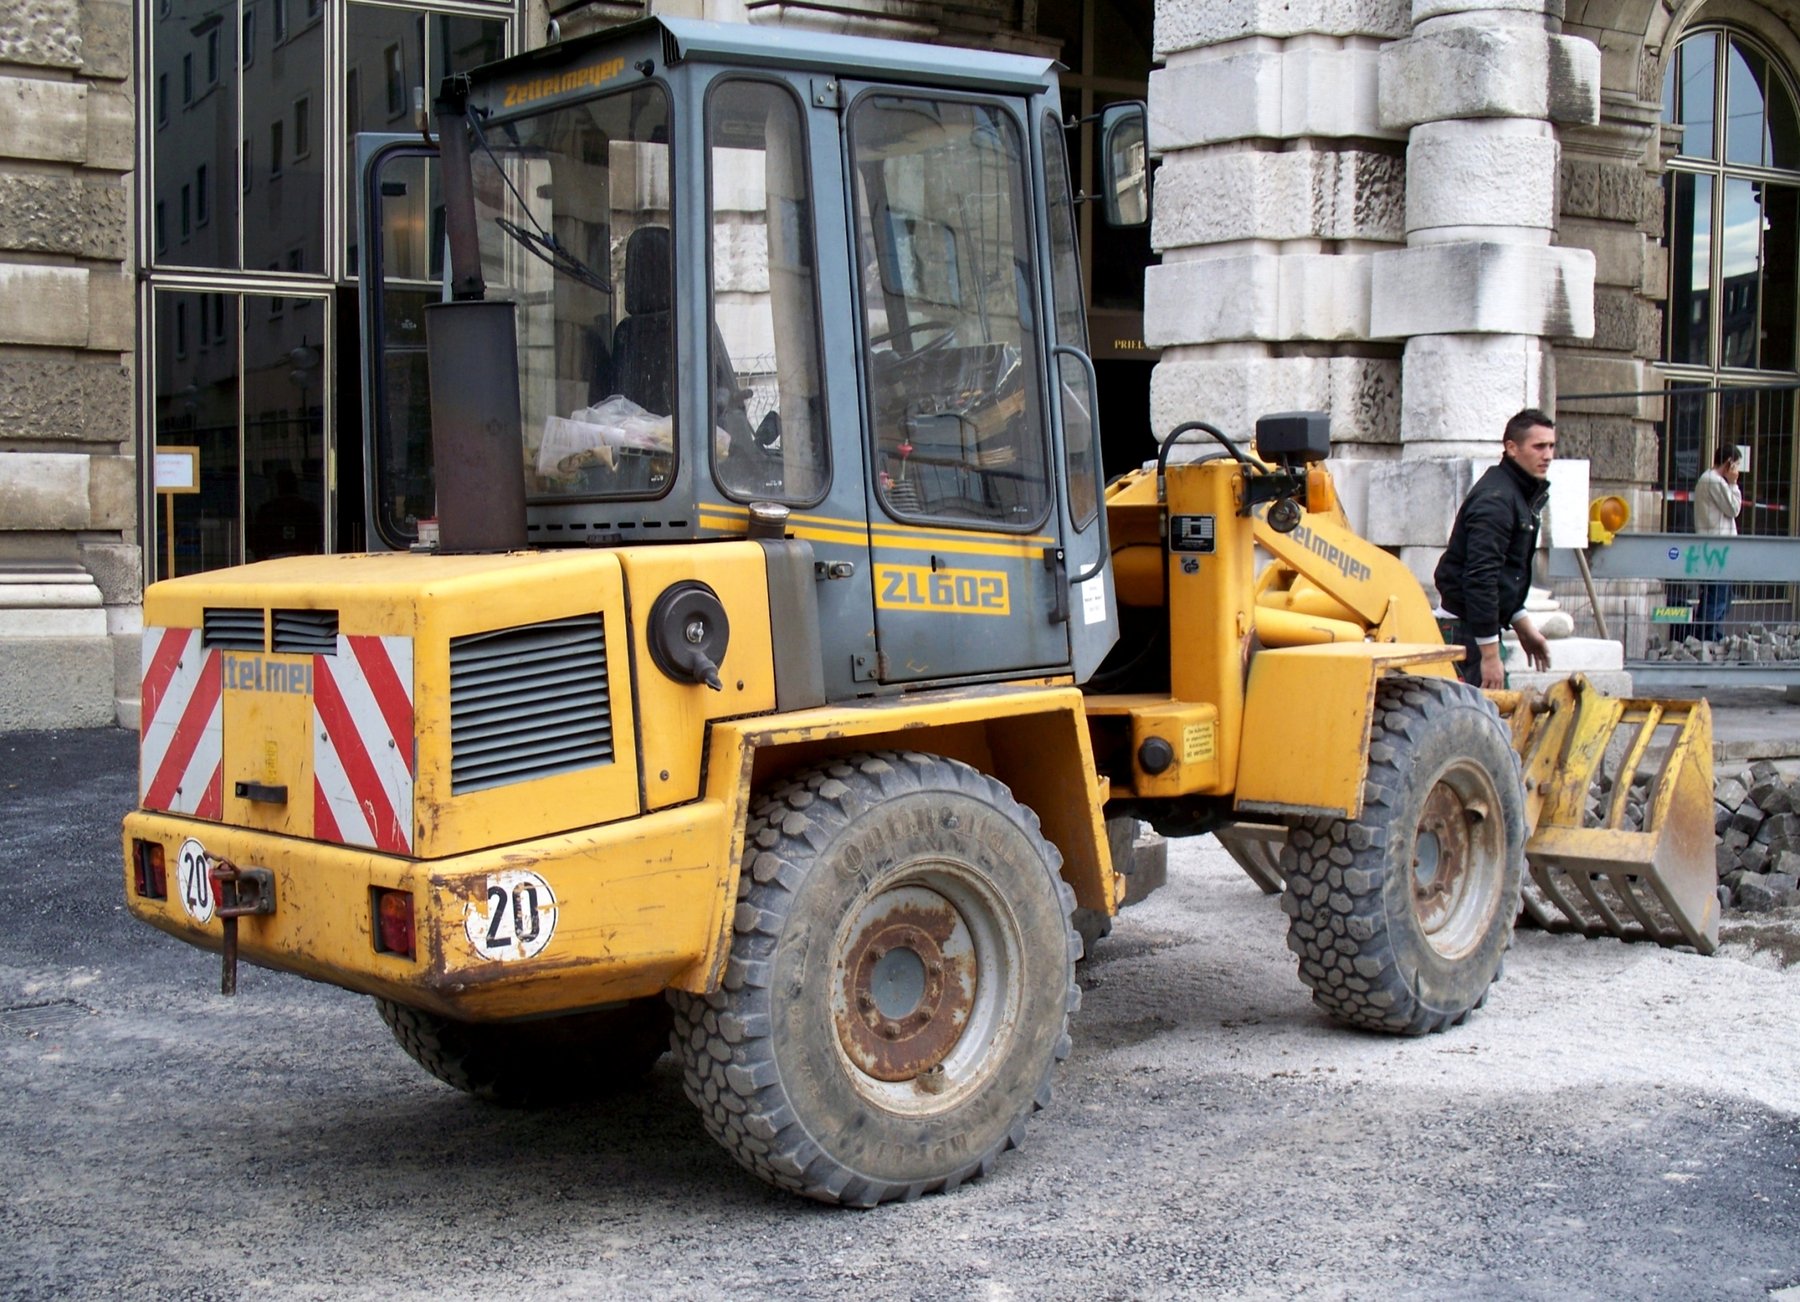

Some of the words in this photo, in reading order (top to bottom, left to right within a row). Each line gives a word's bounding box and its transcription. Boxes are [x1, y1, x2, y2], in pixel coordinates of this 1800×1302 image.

[881, 571, 1004, 609] ZL602
[1655, 608, 1688, 617] HAWE
[185, 852, 208, 908] 20
[486, 882, 540, 949] 20
